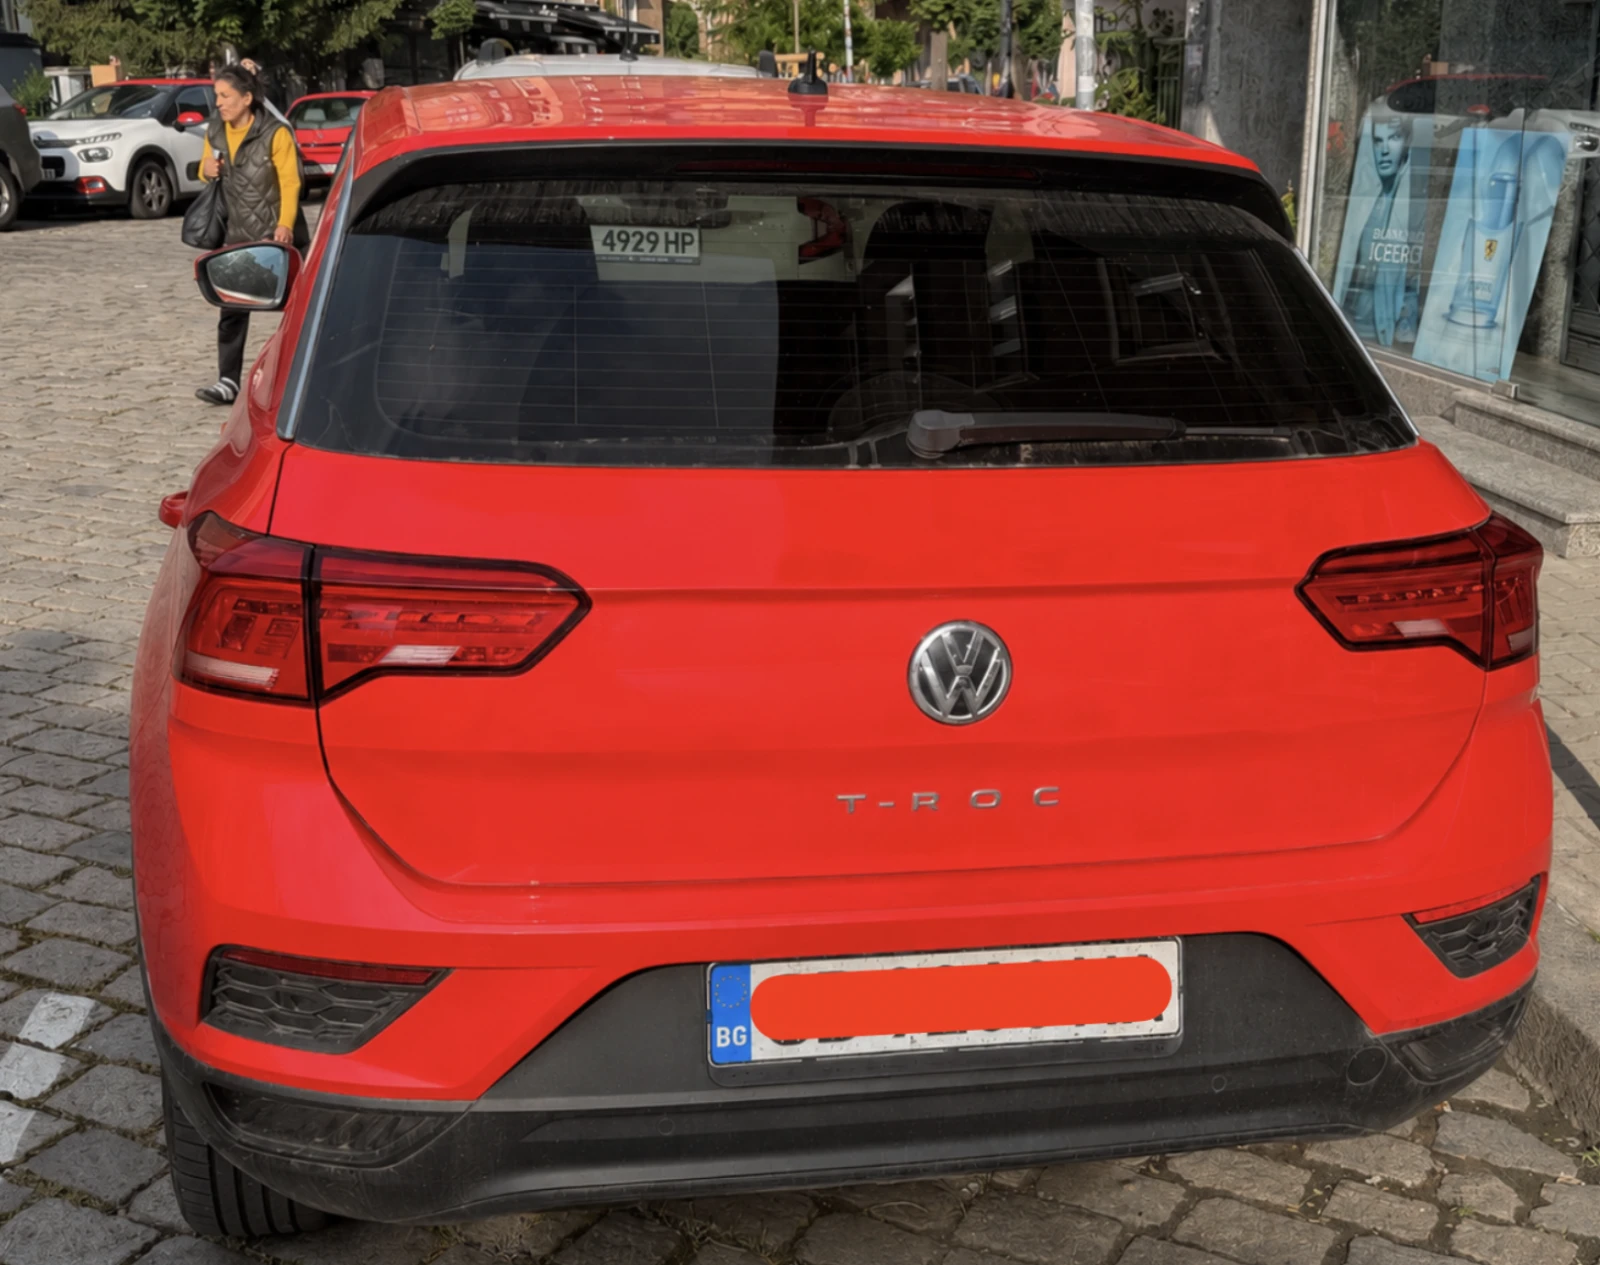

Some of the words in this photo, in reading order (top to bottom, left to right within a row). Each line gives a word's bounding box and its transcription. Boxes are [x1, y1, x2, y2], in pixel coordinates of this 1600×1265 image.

[602, 229, 660, 253] 4929
[664, 231, 695, 254] HP
[836, 786, 1060, 814] T-ROC
[716, 1025, 748, 1048] BG
